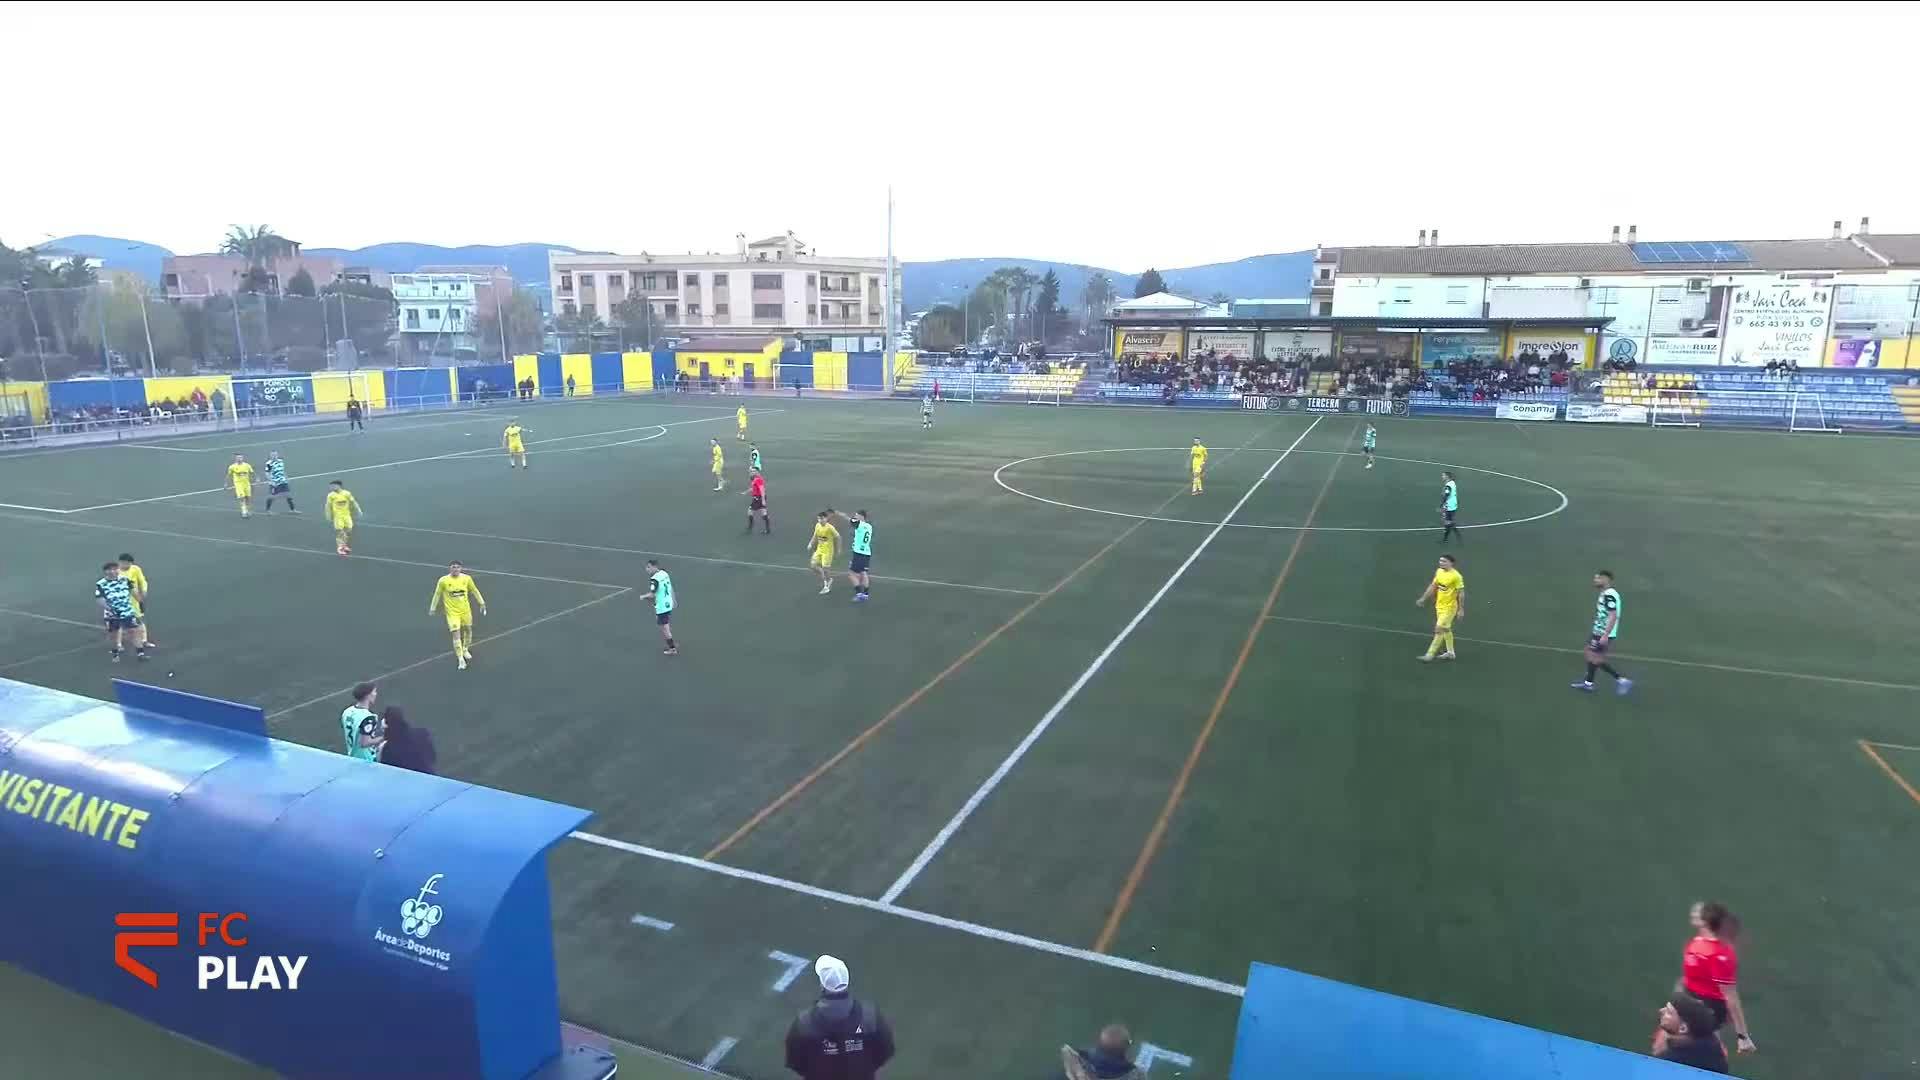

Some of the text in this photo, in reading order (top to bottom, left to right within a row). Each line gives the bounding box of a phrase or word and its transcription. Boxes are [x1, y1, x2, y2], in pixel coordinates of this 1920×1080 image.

[1307, 397, 1340, 409] TERCERA
[863, 531, 870, 544] 6
[0, 769, 149, 849] VISITANTE
